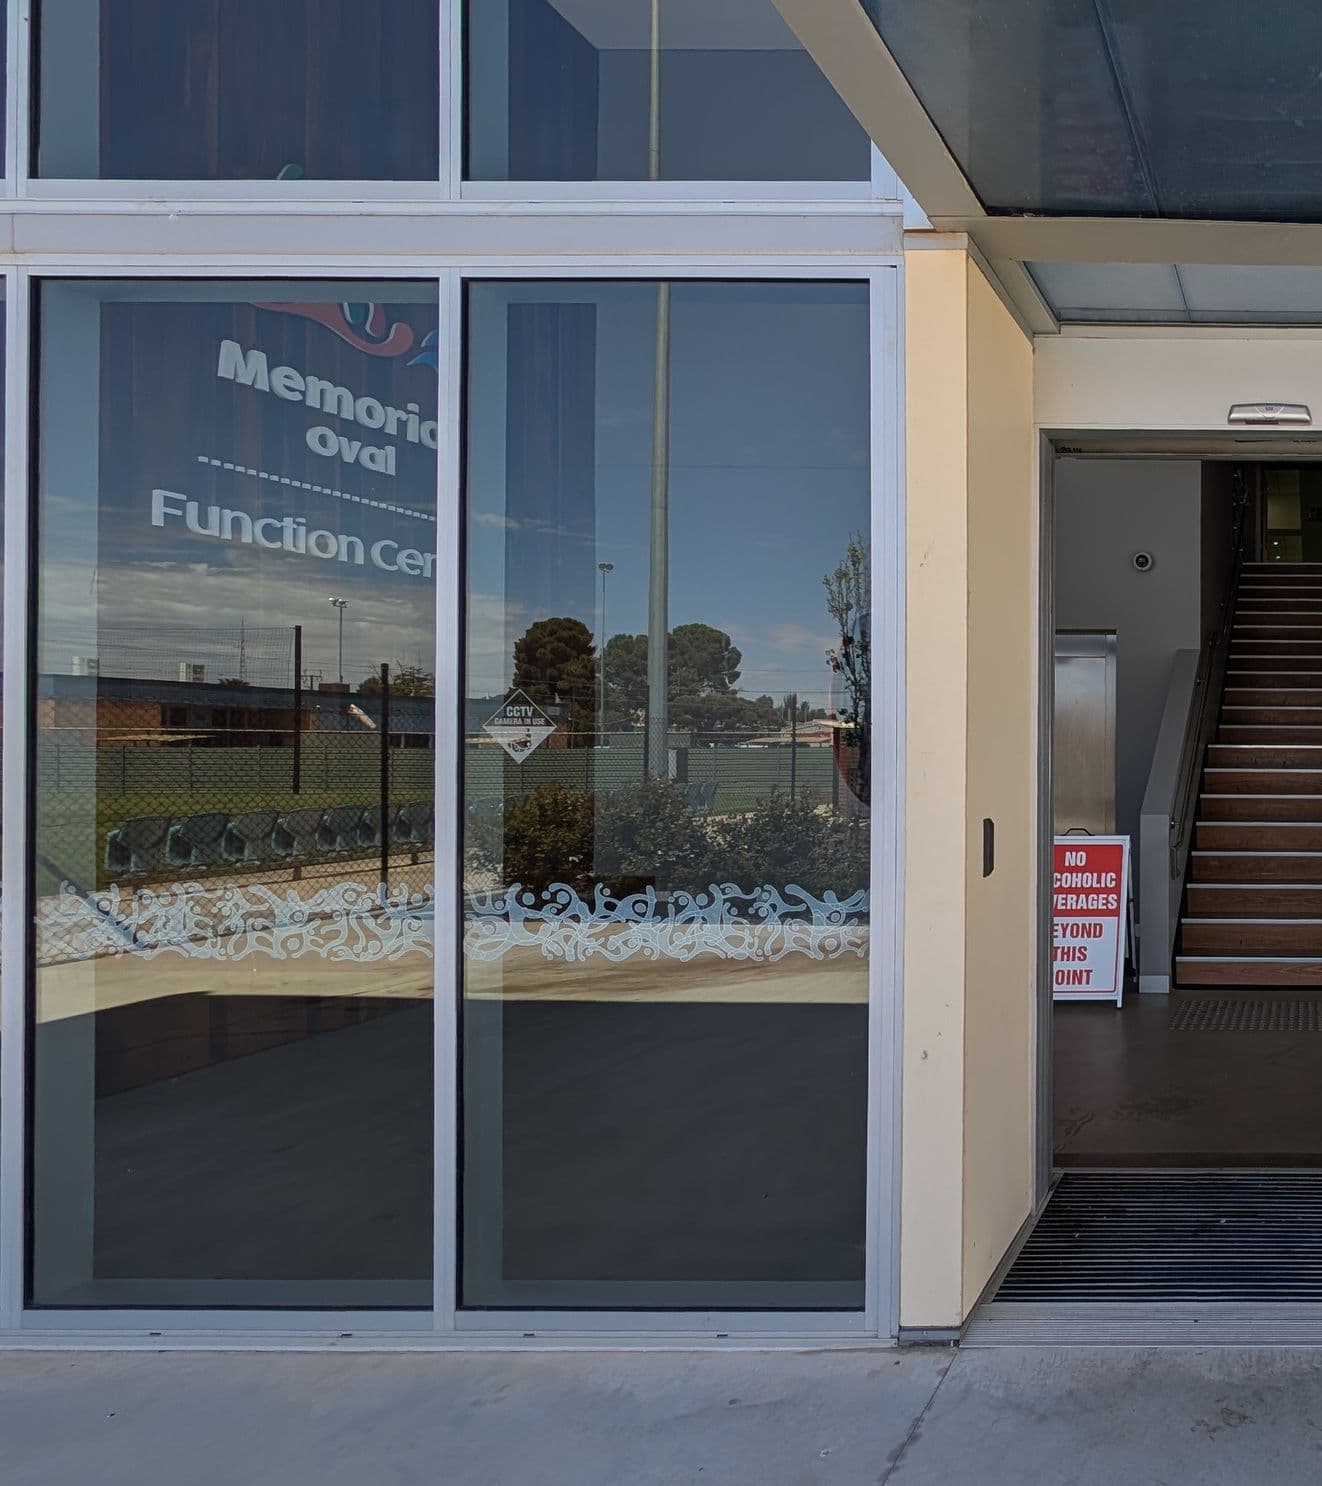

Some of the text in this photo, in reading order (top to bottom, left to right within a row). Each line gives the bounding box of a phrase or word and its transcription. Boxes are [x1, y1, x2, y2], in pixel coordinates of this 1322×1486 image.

[305, 424, 396, 477] Oval
[151, 488, 365, 565] Function
[506, 706, 534, 717] CCTV
[494, 717, 523, 725] CAMERA
[532, 717, 545, 725] USE
[1064, 851, 1086, 866] NO
[1053, 946, 1087, 962] THIS
